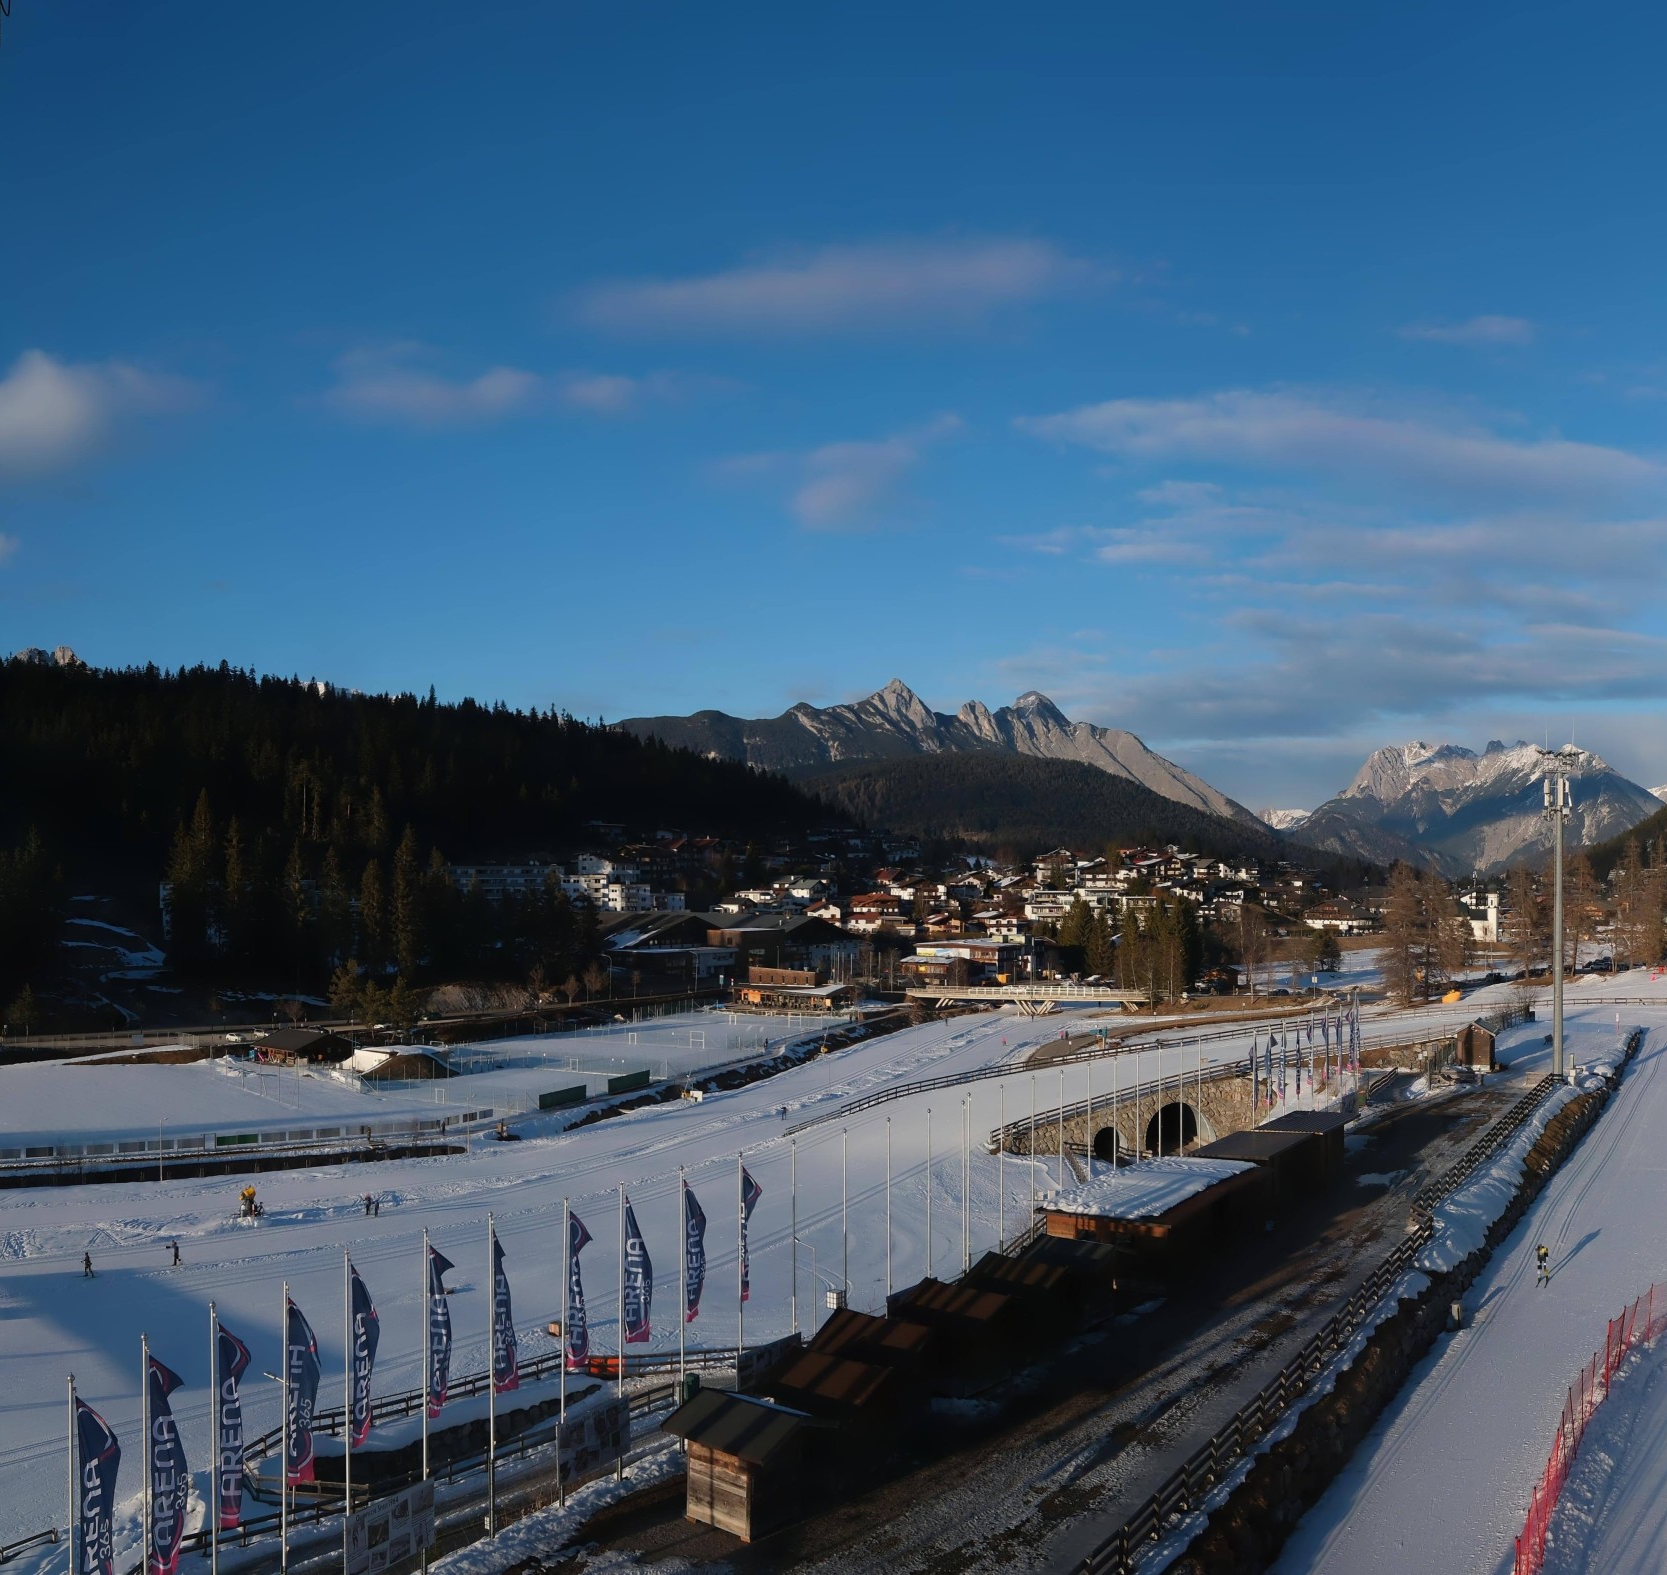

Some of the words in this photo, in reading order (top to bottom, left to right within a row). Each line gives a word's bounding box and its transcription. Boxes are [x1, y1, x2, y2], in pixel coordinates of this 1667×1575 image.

[299, 1398, 312, 1429] 365
[354, 1312, 369, 1420] ARENA
[152, 1415, 176, 1546] ARENA
[175, 1472, 188, 1510] 365
[221, 1376, 244, 1496] ARENA
[83, 1457, 102, 1575] RENA
[99, 1518, 111, 1559] 365
